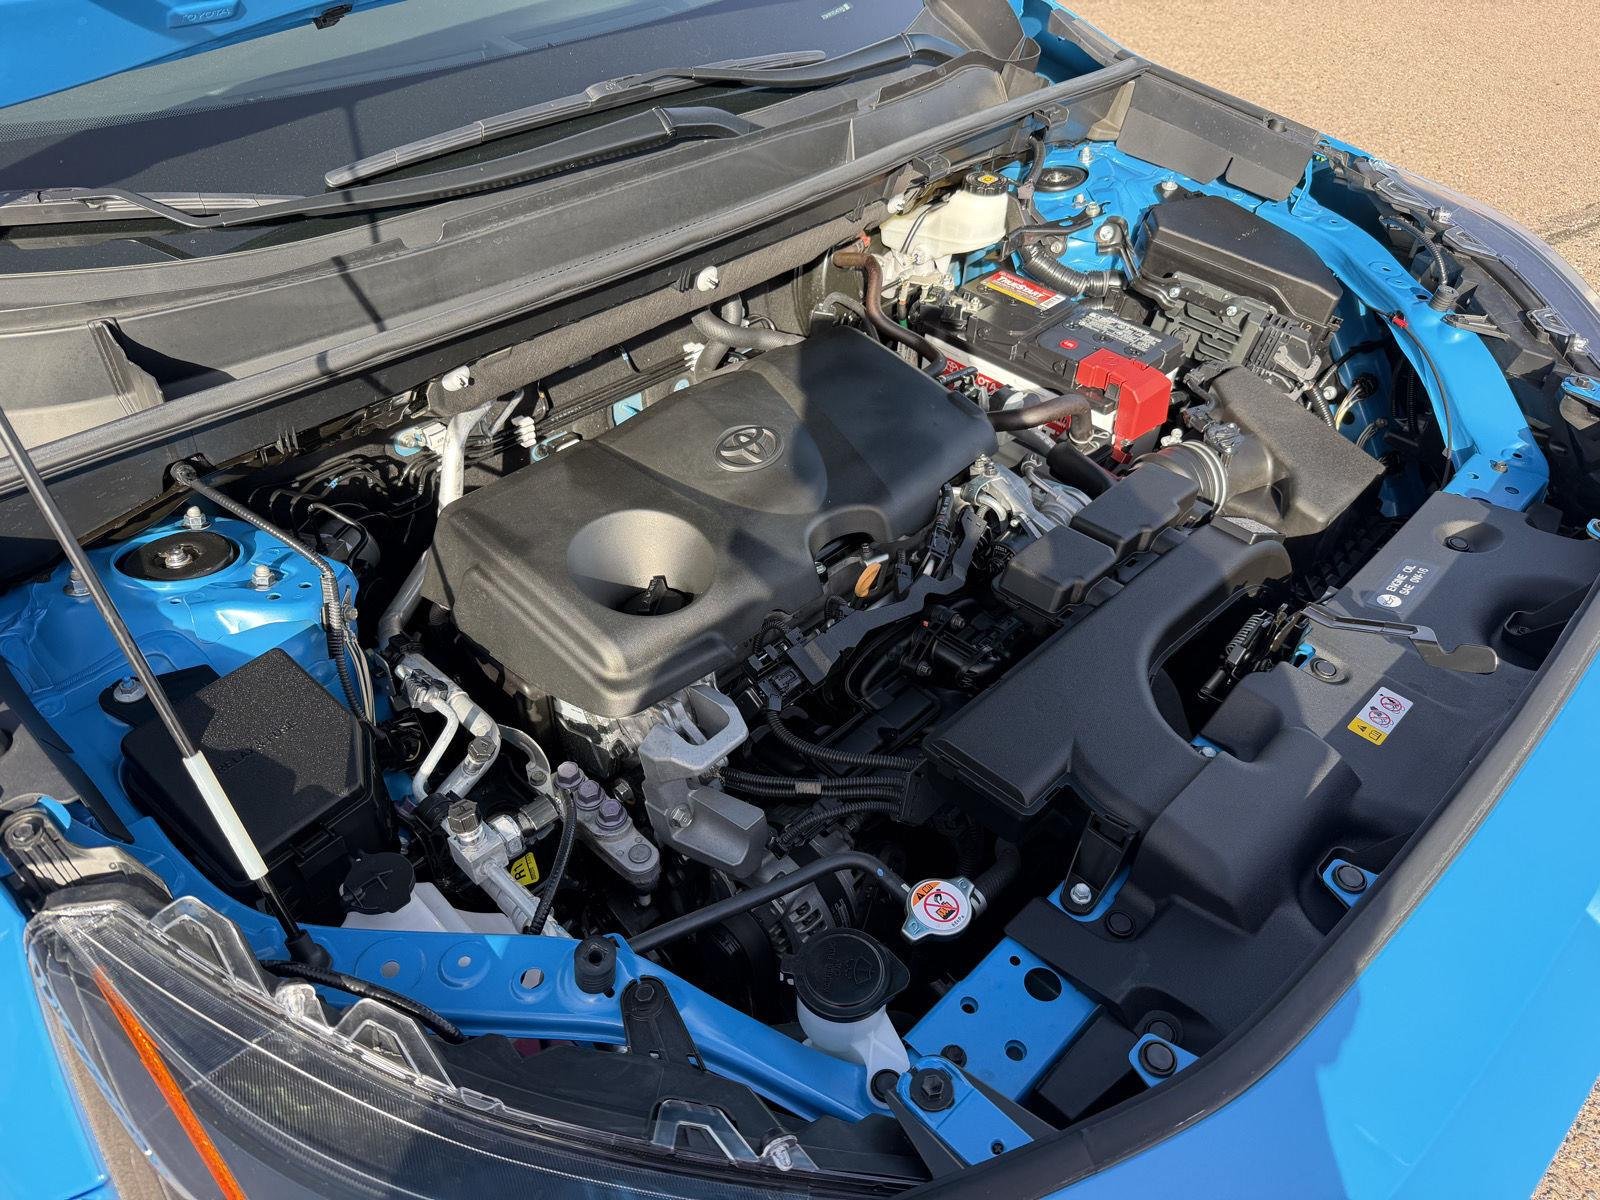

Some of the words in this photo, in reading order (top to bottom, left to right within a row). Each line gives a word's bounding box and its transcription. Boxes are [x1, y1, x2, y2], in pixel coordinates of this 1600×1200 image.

[182, 8, 231, 22] TOYOTA
[1385, 573, 1408, 592] ENGINE
[1402, 565, 1417, 573] OIL
[1399, 583, 1415, 596] SAE
